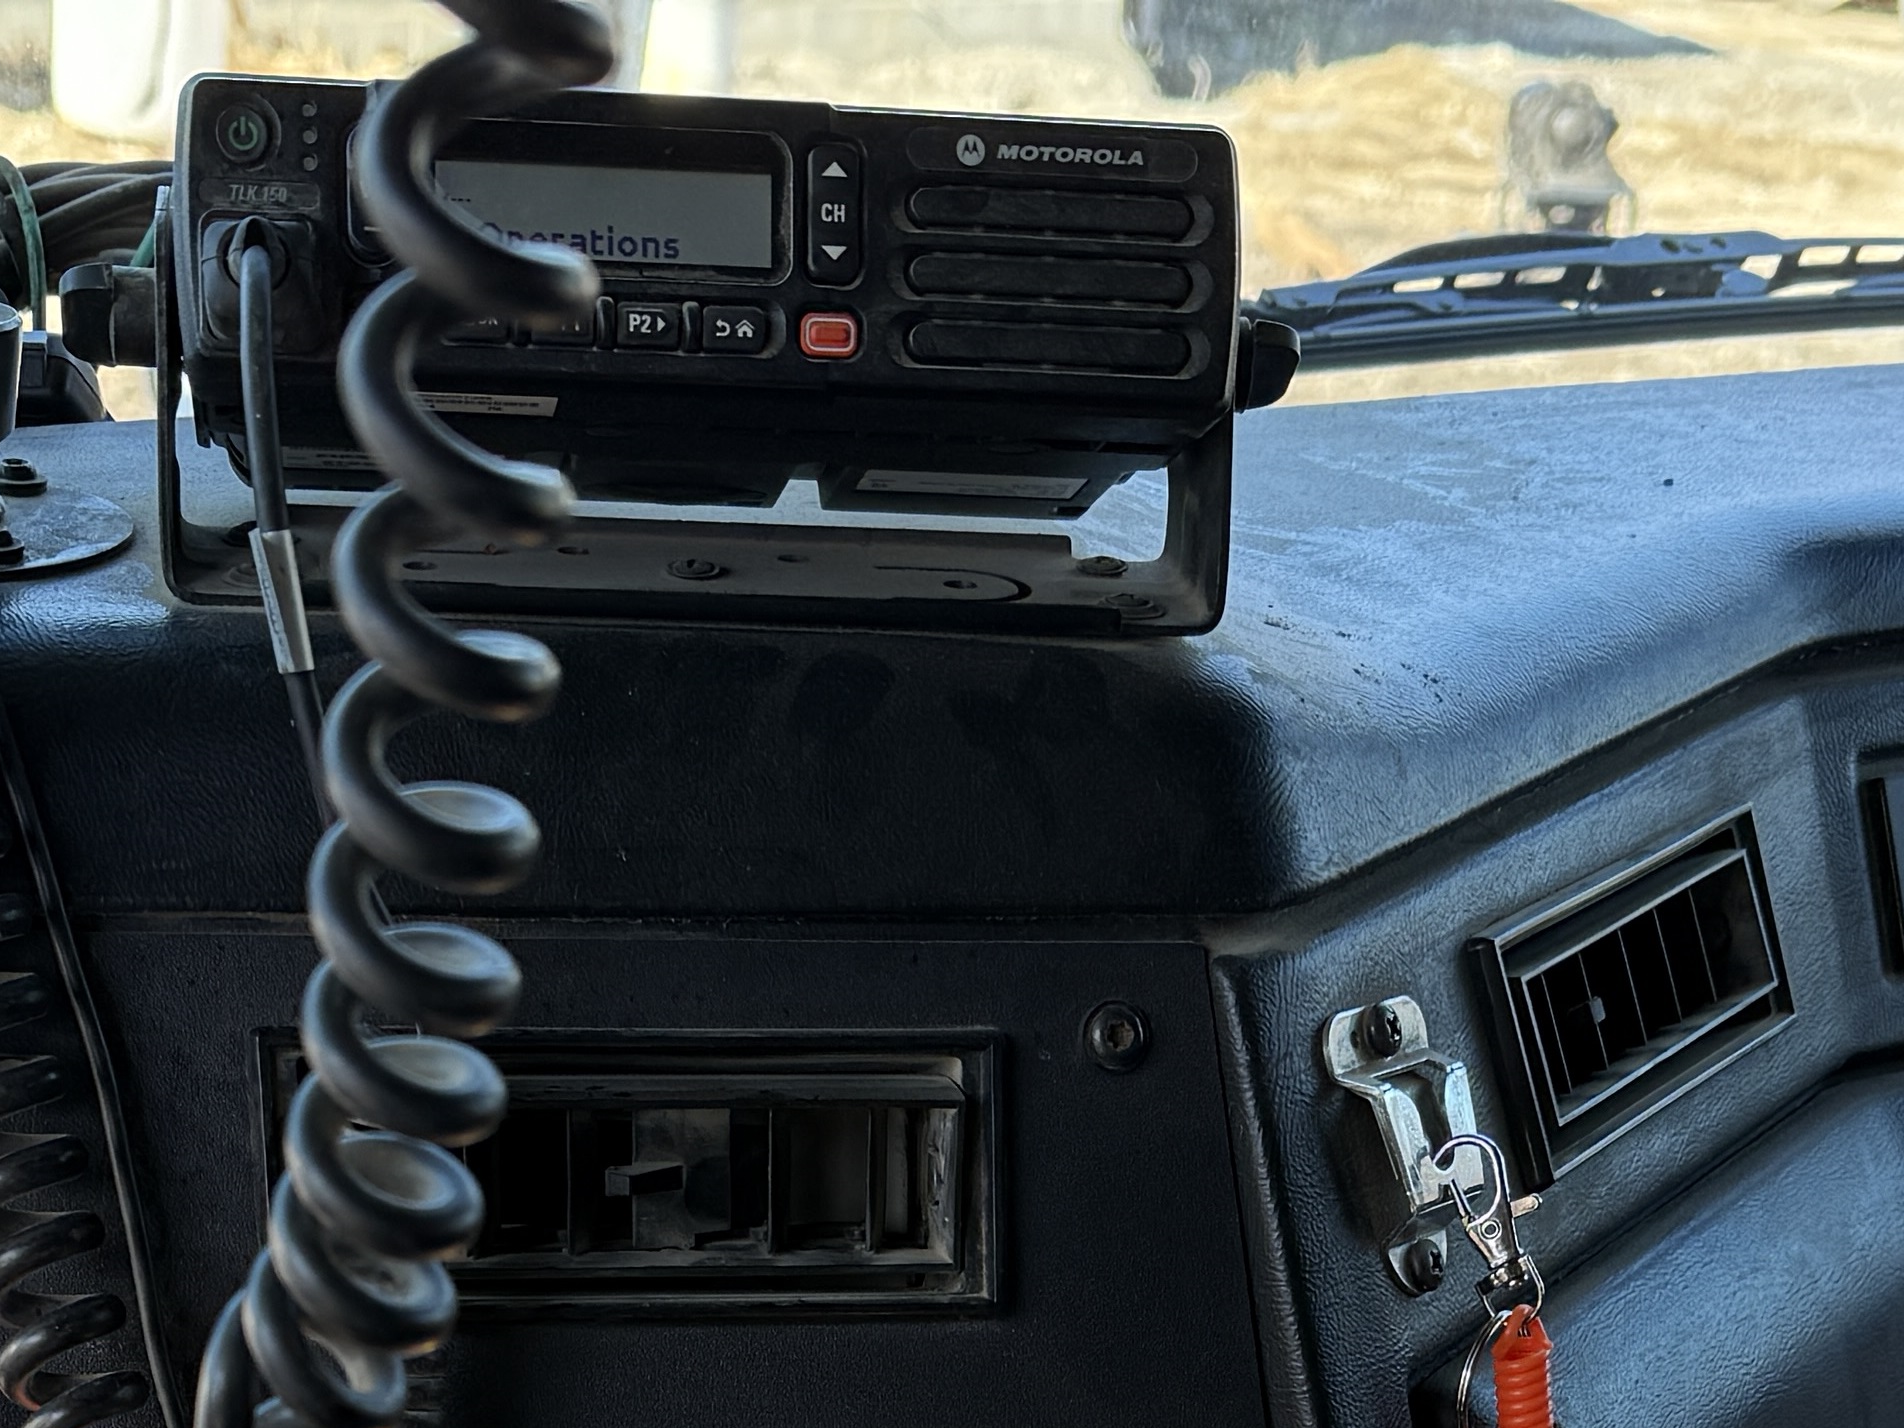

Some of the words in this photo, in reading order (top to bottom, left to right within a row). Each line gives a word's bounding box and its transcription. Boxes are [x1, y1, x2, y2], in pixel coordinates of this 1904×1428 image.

[997, 144, 1144, 166] MOTOROLA
[229, 184, 259, 201] TLK
[262, 185, 288, 201] 150
[821, 203, 845, 223] CH
[629, 313, 651, 334] P2
